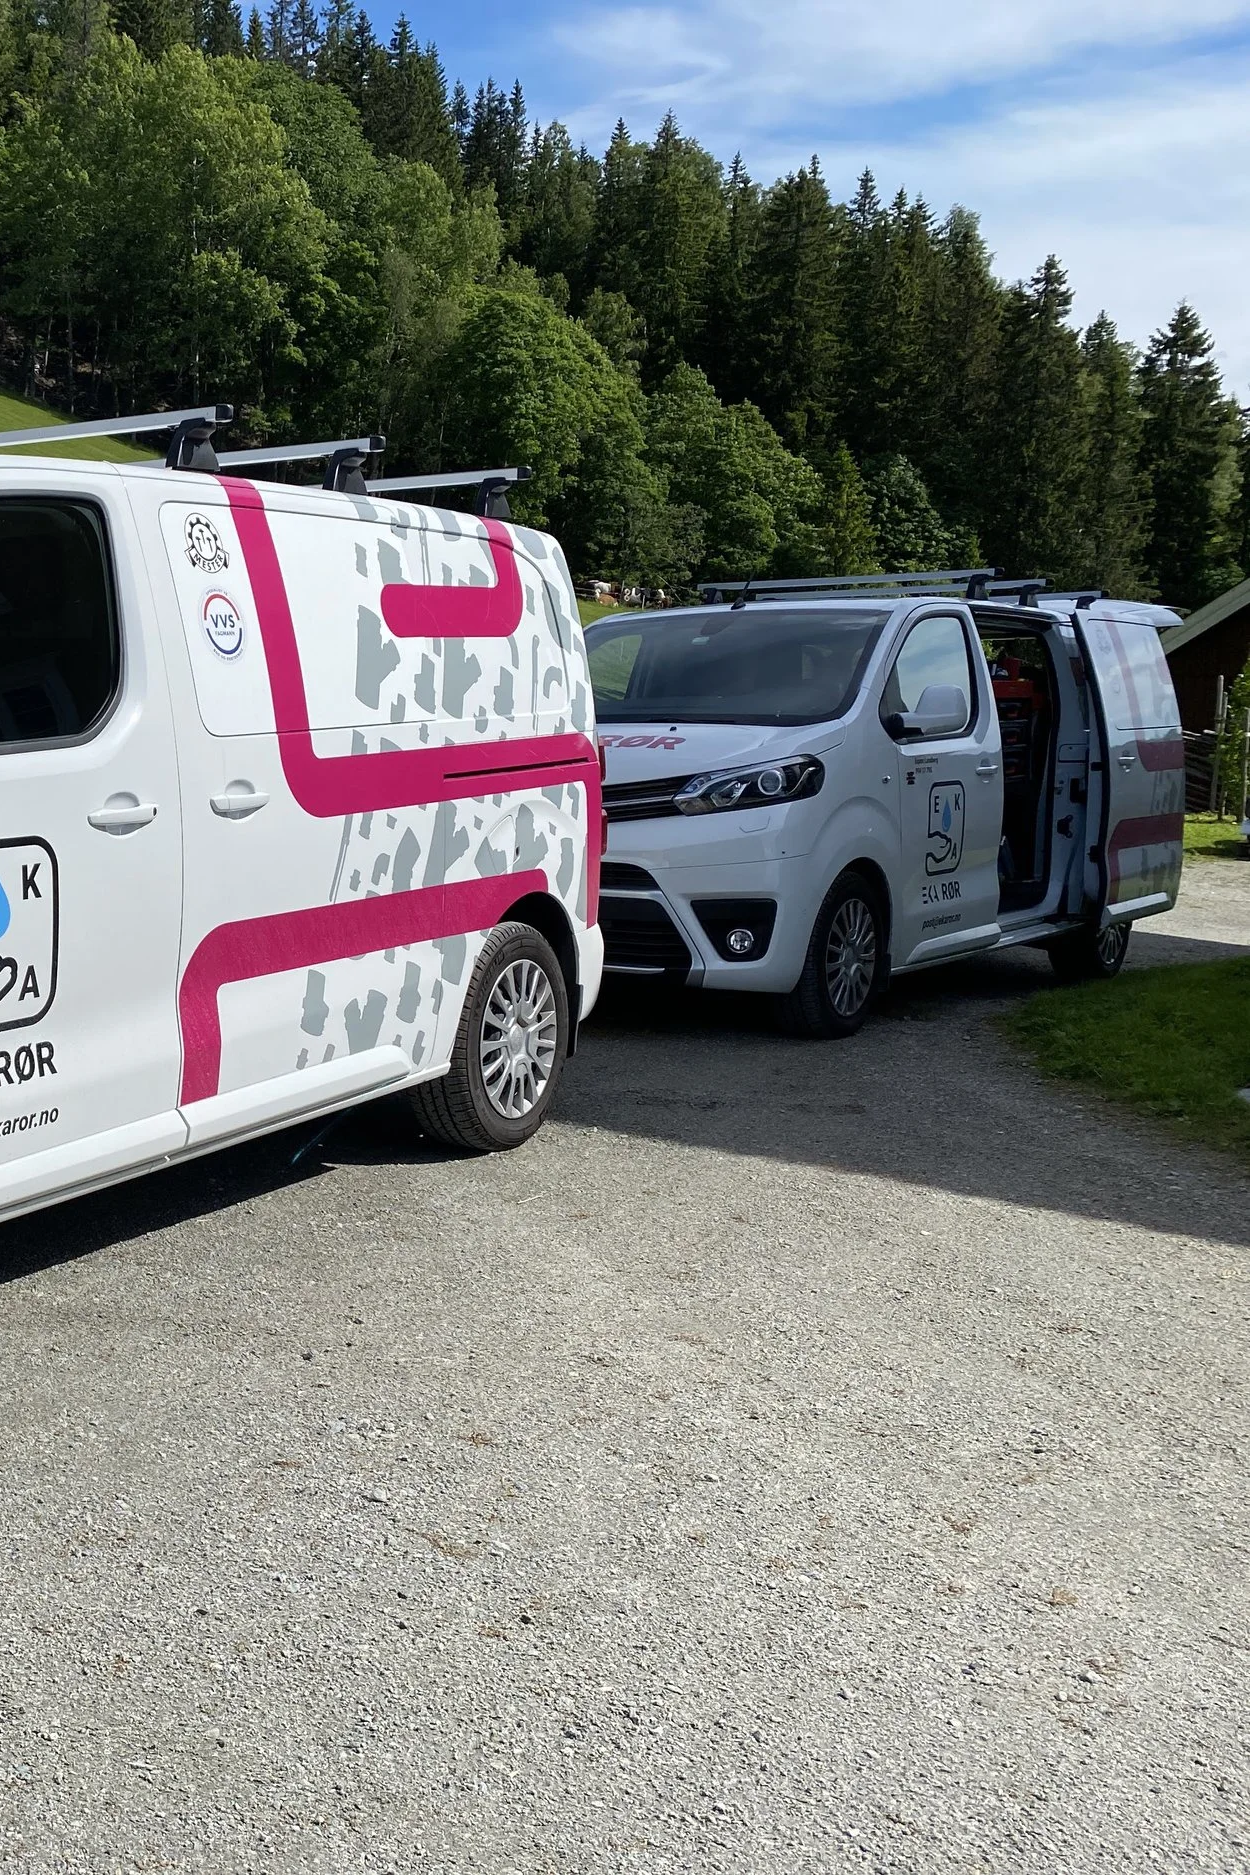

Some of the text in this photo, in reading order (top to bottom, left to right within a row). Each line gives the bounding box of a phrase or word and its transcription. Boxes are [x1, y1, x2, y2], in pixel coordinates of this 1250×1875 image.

[194, 553, 224, 571] MESTER
[211, 614, 236, 628] VVS
[934, 793, 961, 813] E K
[951, 843, 957, 860] A
[21, 863, 42, 900] K
[922, 881, 962, 904] EKA RØR
[18, 965, 40, 1001] A
